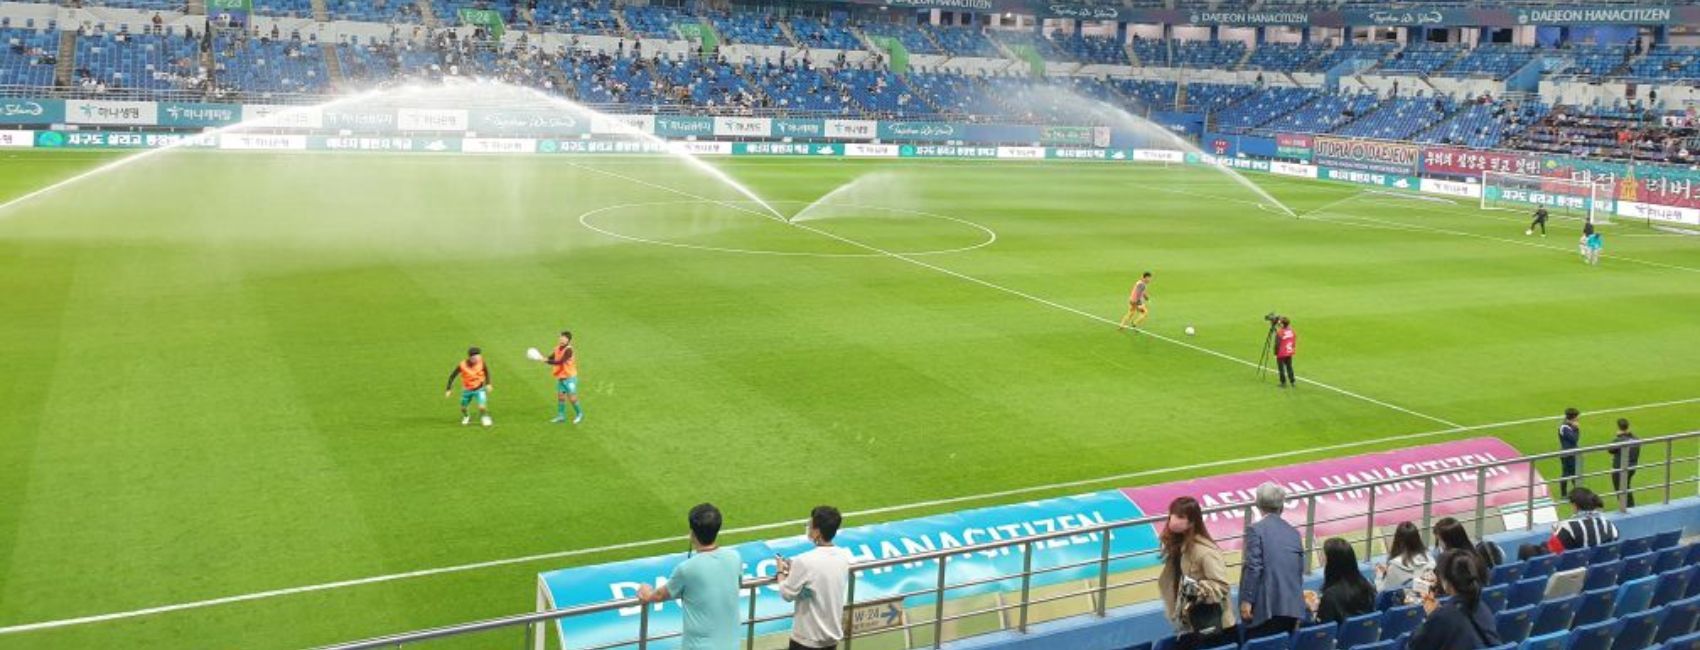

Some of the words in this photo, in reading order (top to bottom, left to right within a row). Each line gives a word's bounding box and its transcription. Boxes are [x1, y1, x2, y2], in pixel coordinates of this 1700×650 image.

[1202, 13, 1245, 22] DAEJEON
[1248, 13, 1308, 23] HANACITIZEN
[1531, 10, 1582, 22] DAEJEON
[1586, 9, 1671, 21] HANACITIZEN
[68, 134, 104, 145] 지구도
[108, 134, 141, 145] 살리고
[1318, 141, 1351, 158] UTOPIA
[1366, 144, 1416, 164] DAEJEON
[1425, 151, 1453, 166] 우리의
[1570, 168, 1615, 193] 대전
[1502, 189, 1528, 202] 지구도
[1529, 192, 1554, 205] 살리고
[1322, 452, 1512, 501] HANACITIZEN
[848, 510, 1117, 578] HANACITIZEN
